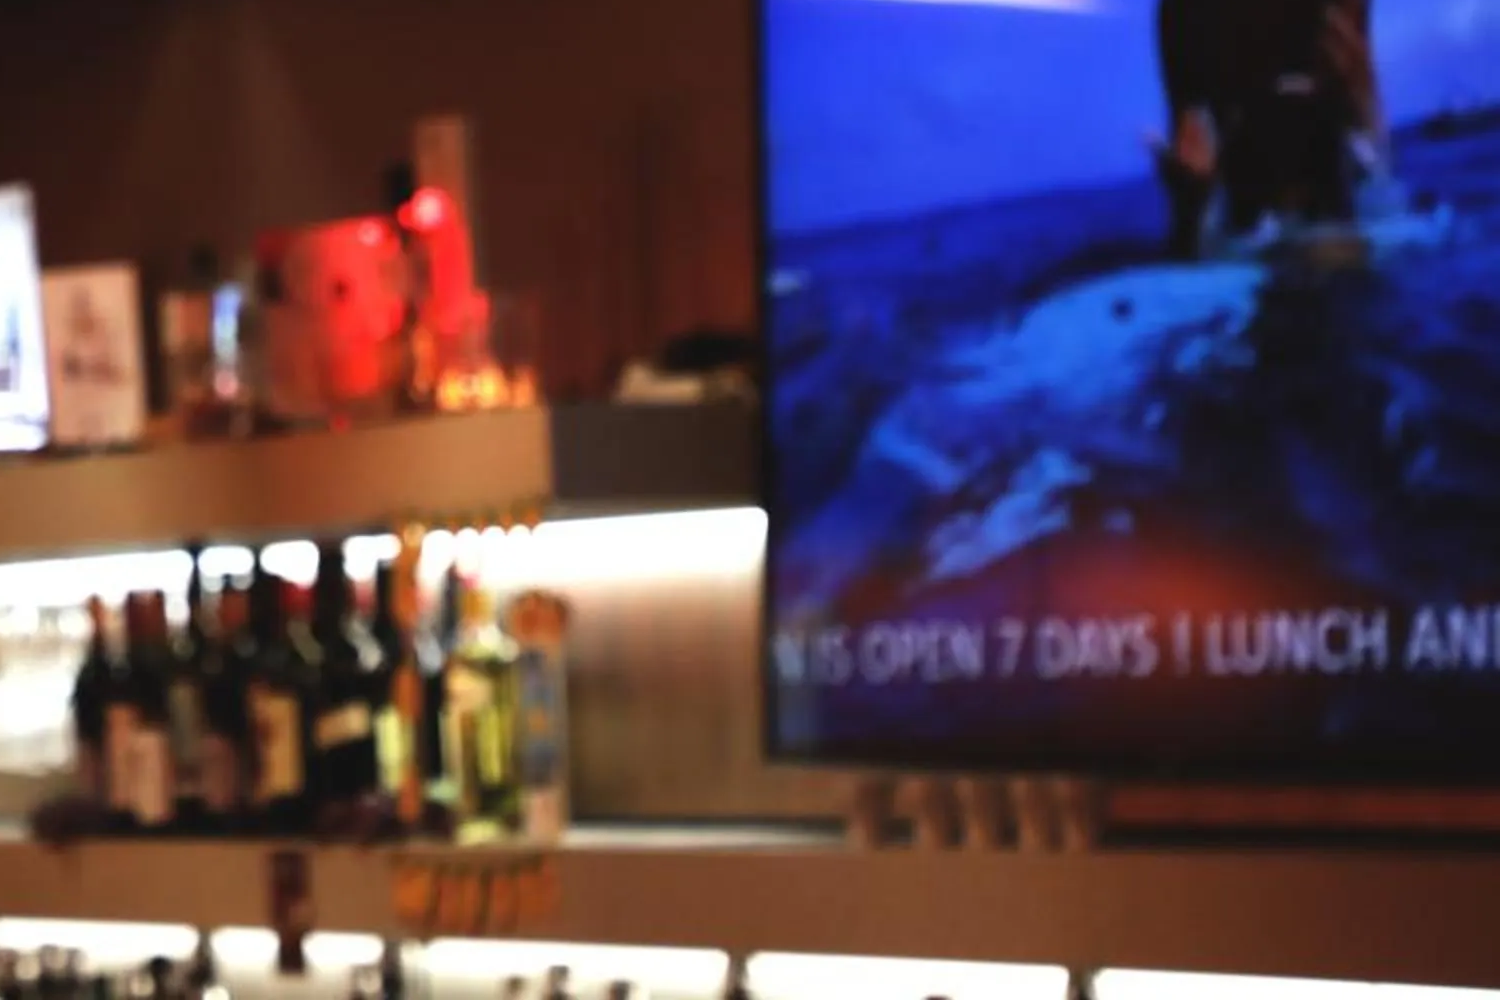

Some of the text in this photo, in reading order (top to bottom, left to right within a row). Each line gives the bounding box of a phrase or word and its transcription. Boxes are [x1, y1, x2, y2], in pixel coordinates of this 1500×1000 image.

[808, 623, 850, 685] IS
[858, 619, 984, 683] OPEN
[997, 616, 1025, 677] 7
[1035, 612, 1157, 679] DAYS
[1205, 606, 1389, 675] LUNCH
